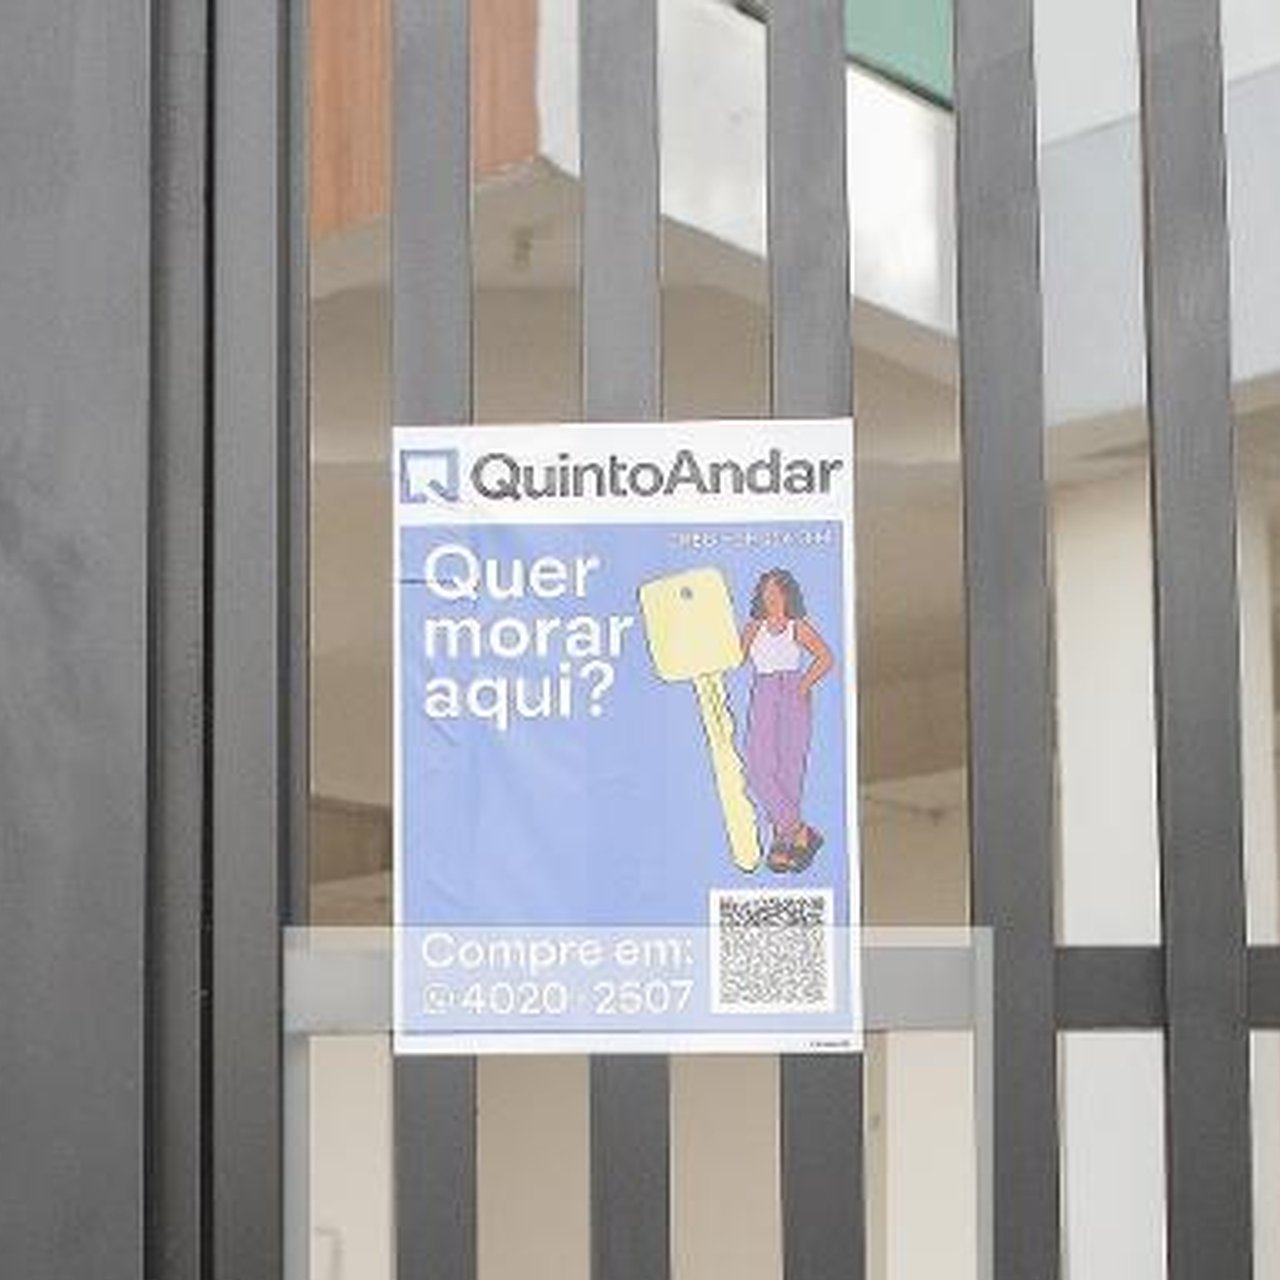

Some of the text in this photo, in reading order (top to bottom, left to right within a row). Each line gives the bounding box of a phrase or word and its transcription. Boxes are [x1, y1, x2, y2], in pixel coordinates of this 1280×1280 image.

[470, 448, 844, 501] QuintoAndar
[424, 544, 600, 602] Quer
[424, 612, 636, 658] morar
[424, 661, 615, 731] aqui?
[422, 932, 695, 976] Compre em:
[462, 981, 568, 1015] 4020
